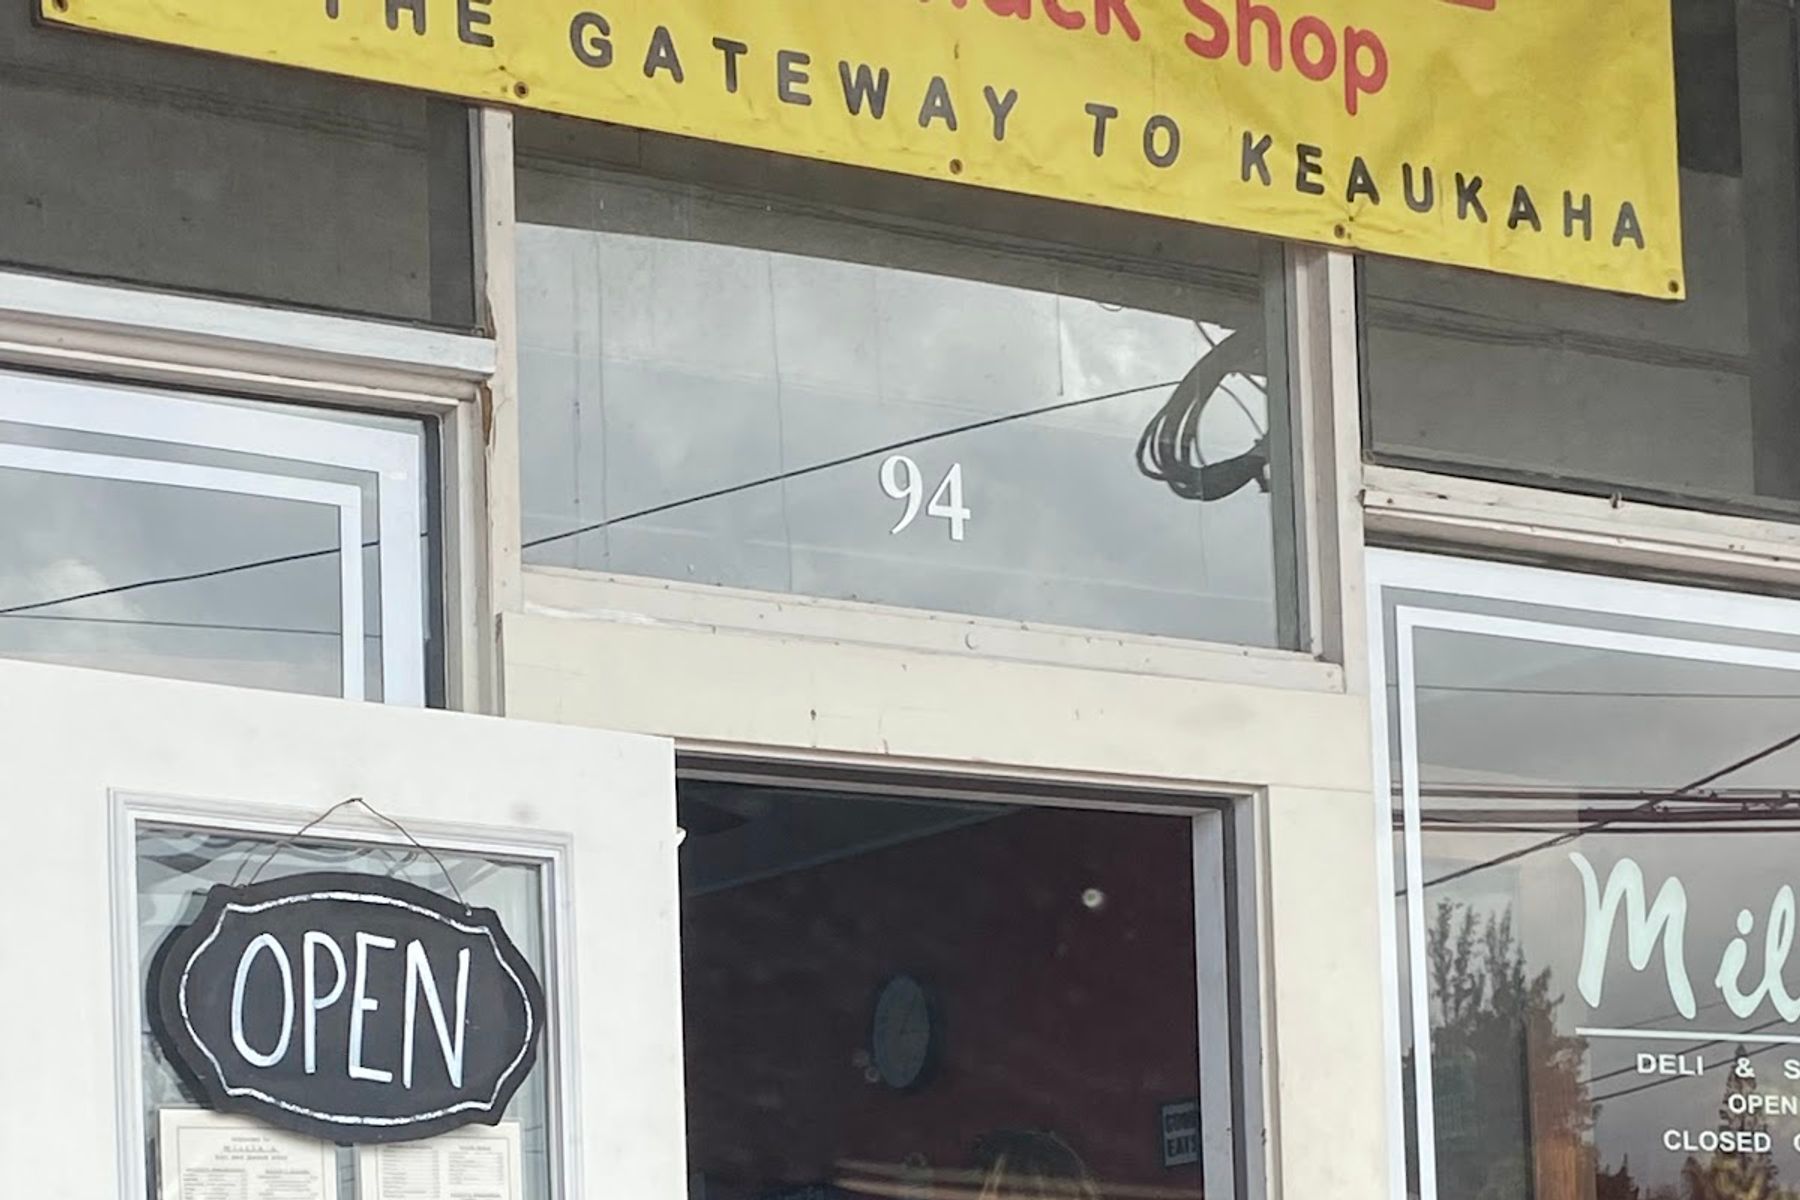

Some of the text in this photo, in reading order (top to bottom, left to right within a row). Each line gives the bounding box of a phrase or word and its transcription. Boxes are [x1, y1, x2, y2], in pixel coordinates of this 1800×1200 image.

[1183, 0, 1389, 116] Shop
[570, 11, 1018, 141] GATEWAY
[1084, 102, 1181, 168] TO
[1241, 131, 1645, 250] KEAUKAHA
[878, 454, 972, 541] 94
[230, 930, 470, 1089] OPEN
[1637, 1053, 1704, 1076] DELI
[1735, 1057, 1756, 1078] &
[1728, 1093, 1798, 1115] OPEN
[1663, 1129, 1772, 1152] CLOSED
